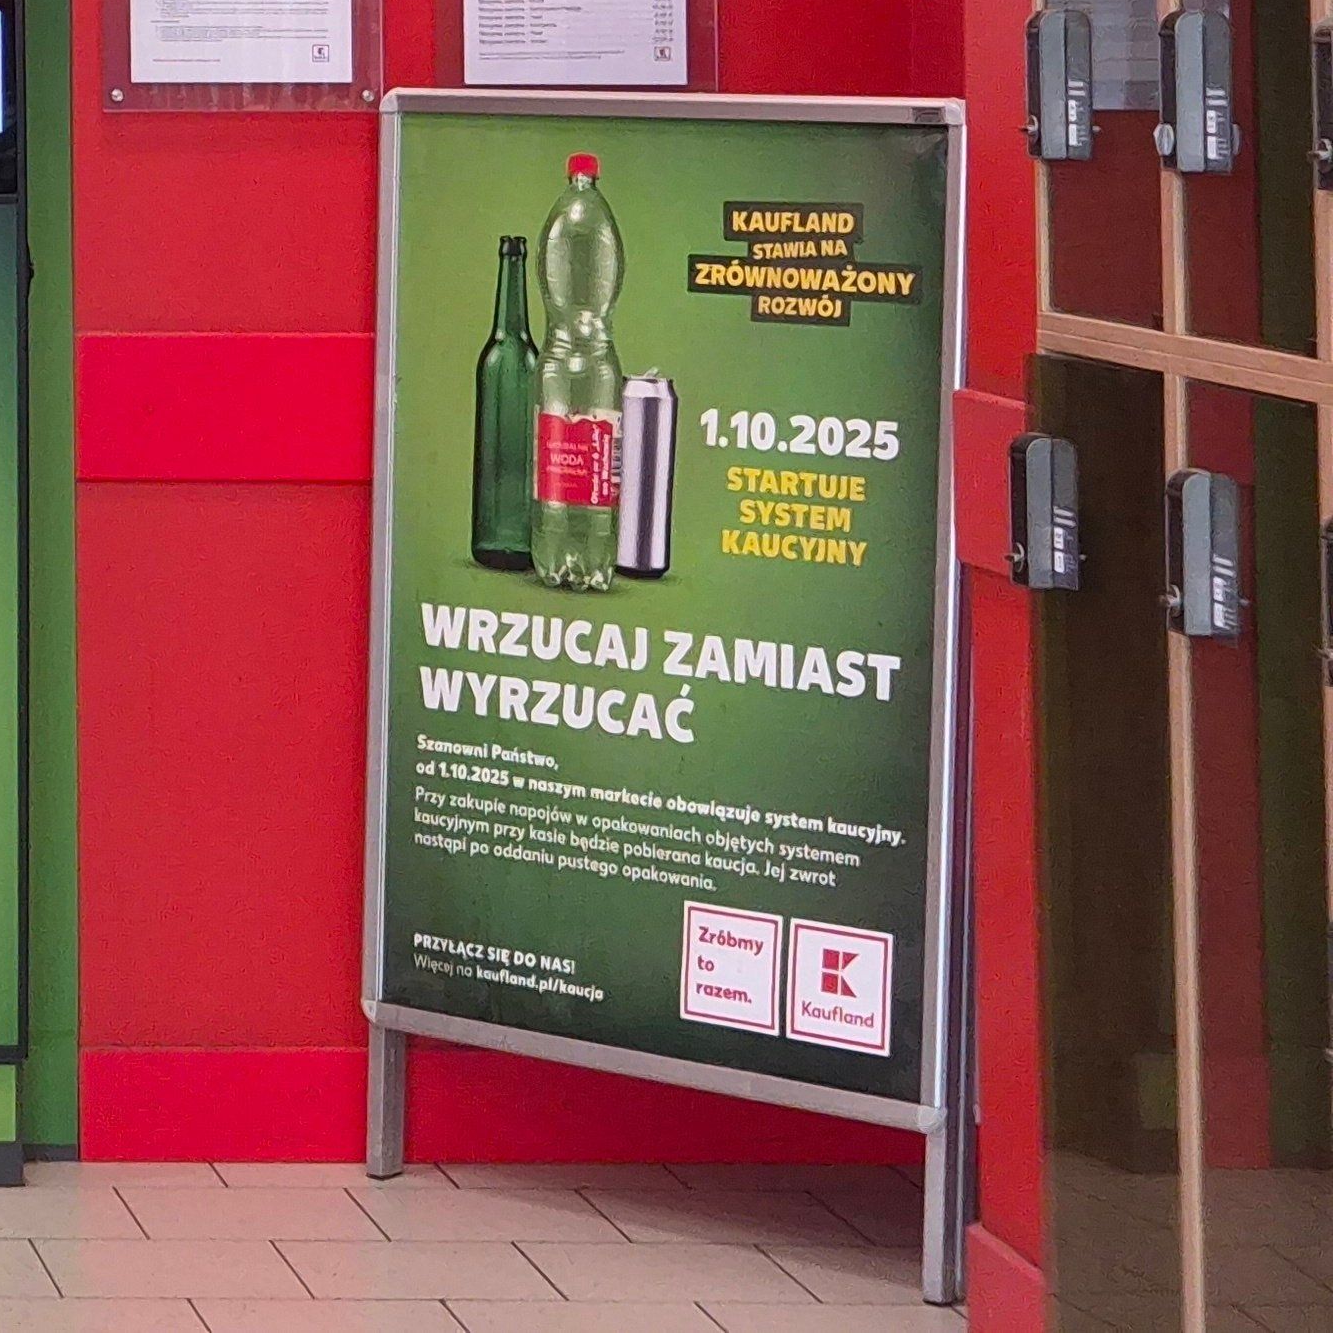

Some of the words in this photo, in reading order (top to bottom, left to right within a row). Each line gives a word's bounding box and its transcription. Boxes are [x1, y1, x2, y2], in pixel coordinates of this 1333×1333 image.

[732, 210, 855, 234] KAUFLAND
[752, 242, 817, 259] STAWIA
[821, 240, 847, 257] NA
[694, 263, 916, 295] ZRÓWNOWAŻONY
[757, 294, 842, 319] ROZWÓJ
[700, 409, 900, 460] 1.10.2025
[726, 467, 866, 502] STARTUJE
[739, 499, 851, 531] SYSTEM
[721, 529, 868, 565] KAUCYJNY
[421, 603, 648, 670] WRZUCAJ
[663, 630, 901, 702] ZAMIAST
[420, 667, 695, 743] WYRZUCAĆ
[417, 735, 487, 758] Szanowni
[492, 744, 559, 769] Państwo,
[416, 761, 435, 775] od
[439, 762, 509, 784] 1.10.2025
[513, 774, 525, 787] w
[528, 777, 586, 799] naszym
[590, 784, 662, 808] markecie
[667, 796, 759, 824] obowiązuje
[765, 810, 822, 832] system
[827, 817, 905, 846] kaucyjny.
[415, 787, 445, 806] Przy
[449, 793, 504, 816] zakupie
[510, 800, 571, 824] napojów
[576, 811, 587, 823] w
[592, 813, 701, 843] opakowaniach
[706, 829, 774, 854] objętych
[779, 841, 859, 866] systemem
[415, 809, 489, 838] kaucyjnym
[494, 822, 524, 841] przy
[530, 825, 566, 843] kasie
[571, 831, 619, 852] będzie
[624, 841, 701, 866] pobierana
[705, 851, 759, 875] kaucja.
[764, 861, 784, 881] Jej
[790, 866, 836, 886] zwrot
[415, 831, 466, 855] nastąpi
[470, 841, 489, 856] po
[494, 841, 554, 864] oddaniu
[559, 852, 618, 877] pustego
[623, 864, 716, 890] opakowania.
[414, 933, 483, 962] PRZYŁĄCZ
[487, 946, 509, 966] SIĘ
[514, 950, 536, 967] DO
[541, 954, 575, 974] NAS!
[698, 927, 764, 955] Zróbmy
[415, 954, 453, 977] Więcej
[457, 964, 472, 977] na
[476, 965, 604, 1002] kaufland.pl/kaucja
[697, 956, 715, 973] to
[697, 982, 752, 1004] razem.
[801, 1001, 874, 1028] Kaufland
